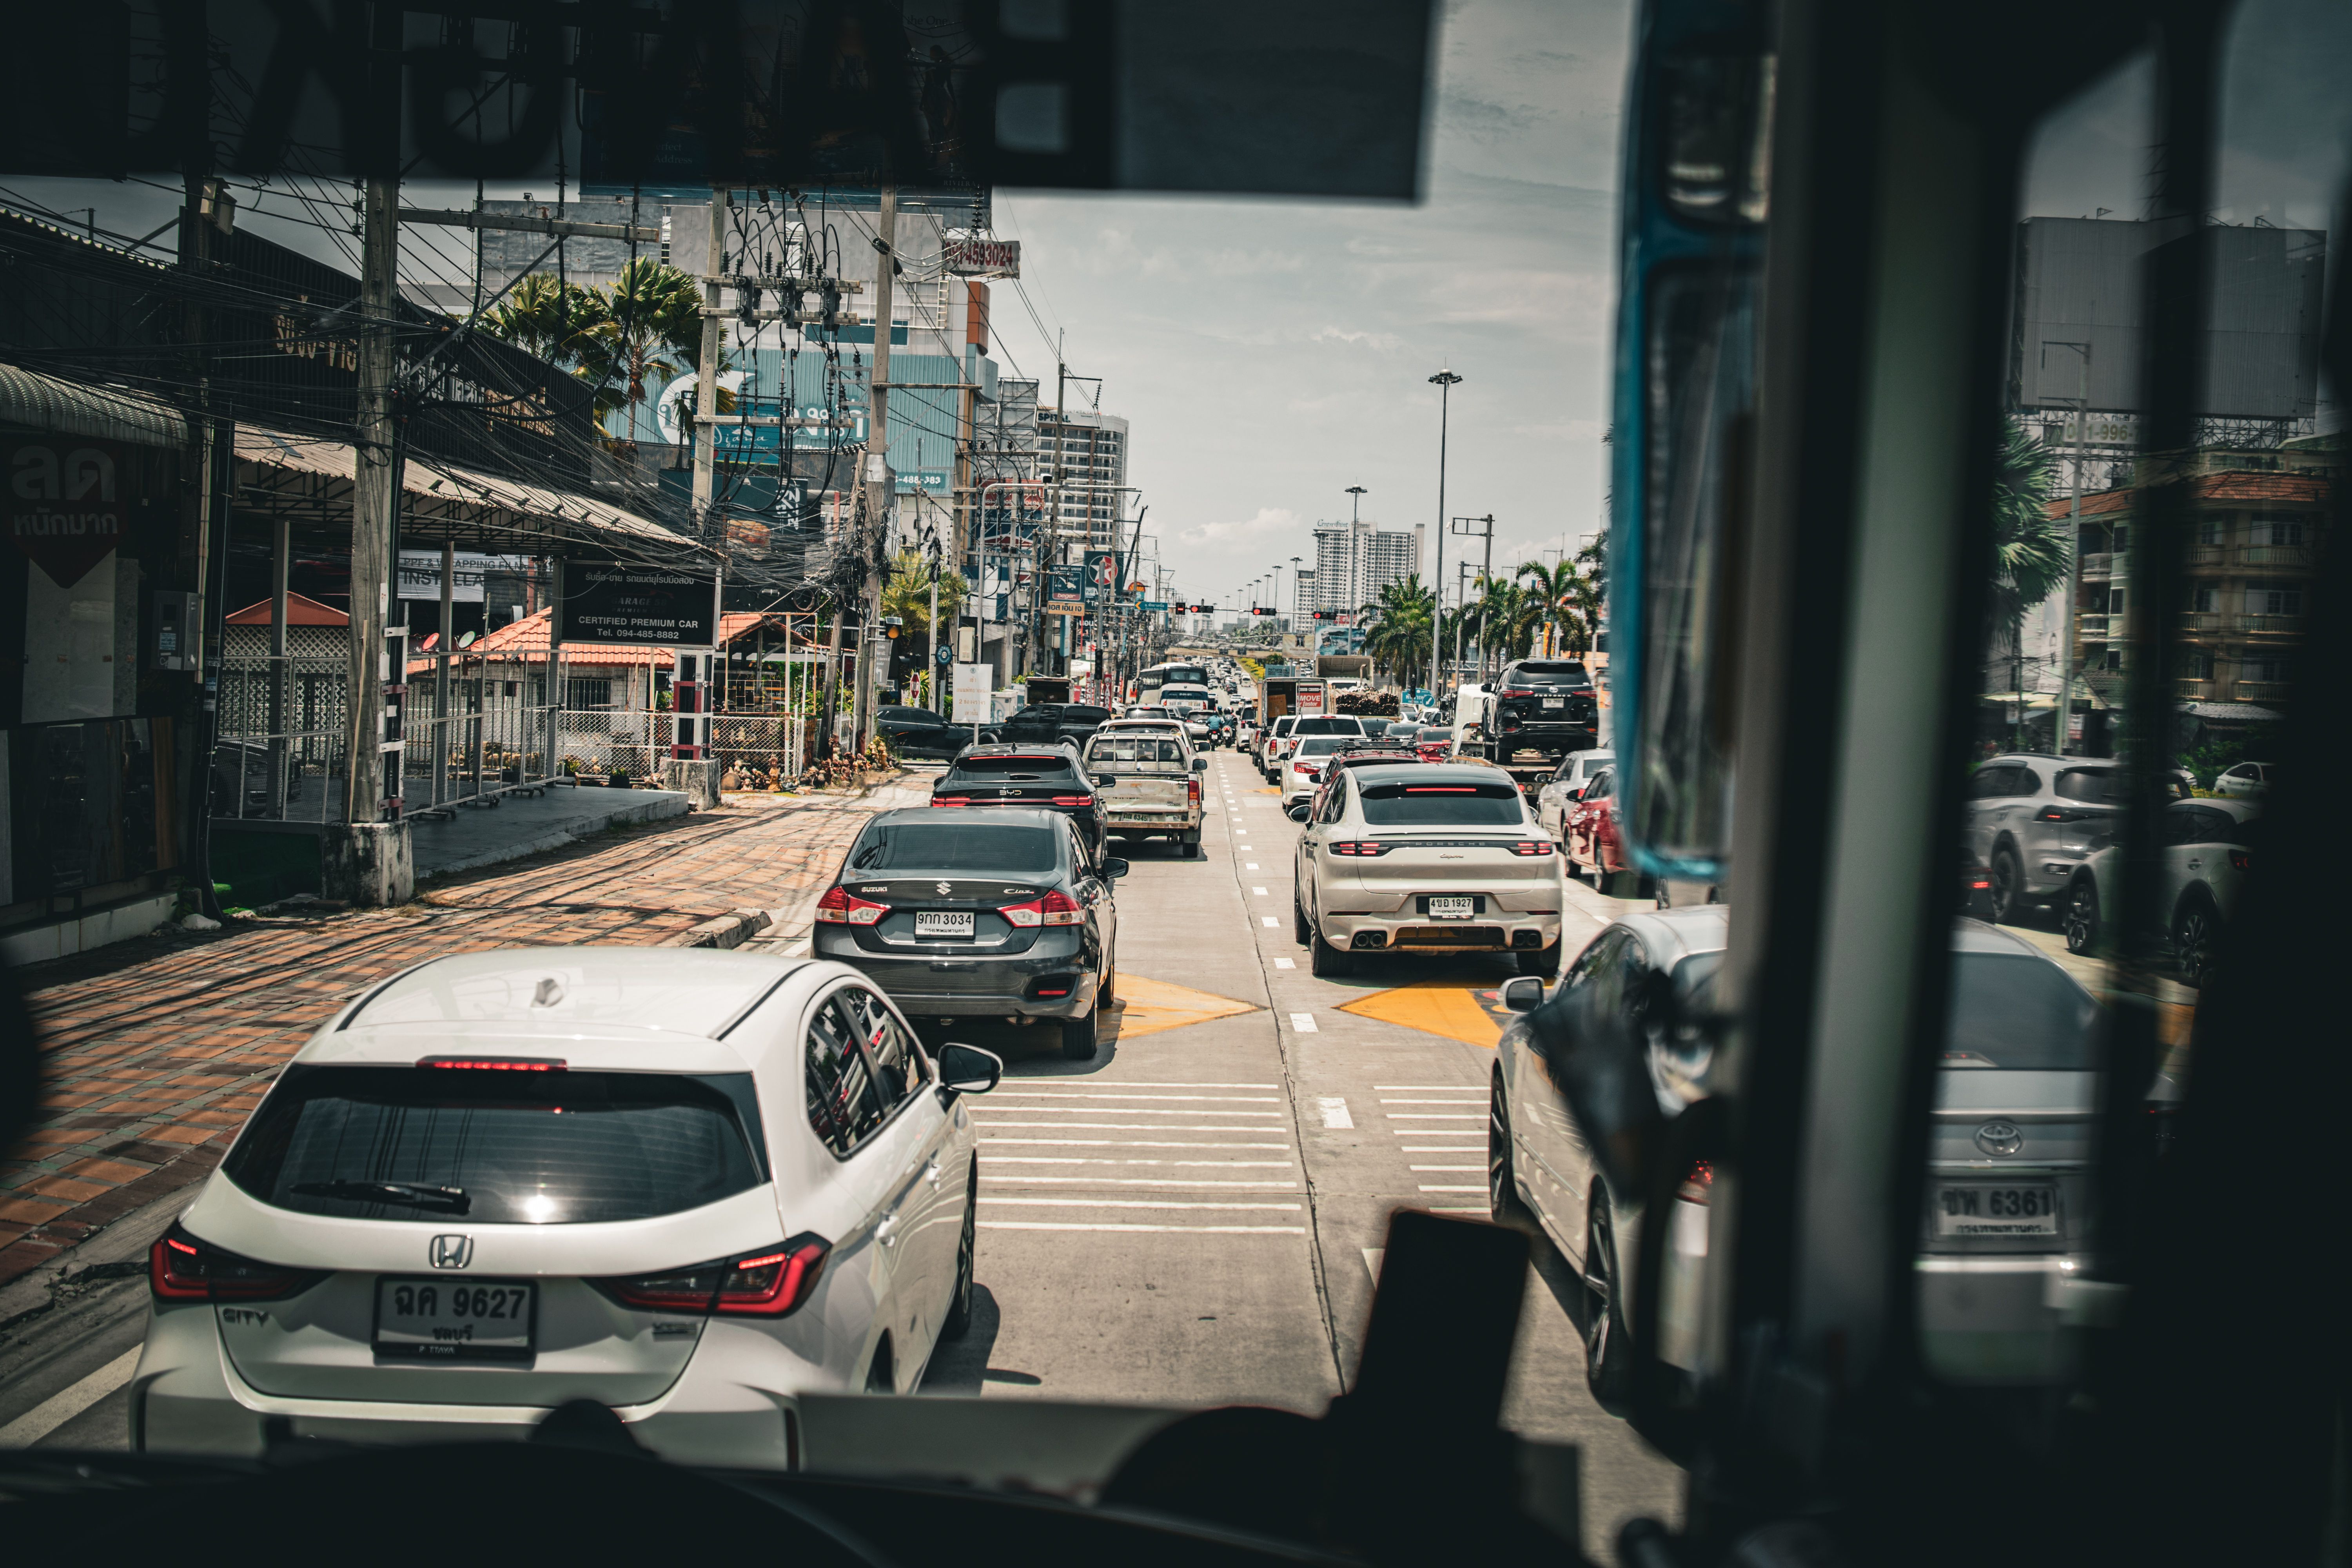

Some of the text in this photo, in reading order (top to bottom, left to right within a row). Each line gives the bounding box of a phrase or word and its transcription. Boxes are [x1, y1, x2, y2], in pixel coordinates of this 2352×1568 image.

[11, 445, 116, 503] ลด
[14, 506, 118, 535] หนักมาก
[437, 559, 495, 568] WAPPING
[611, 597, 651, 606] GARAGE
[579, 616, 627, 625] CERTIFIED
[631, 618, 675, 627] PREMIUM
[597, 628, 679, 639] Tel. 094-485-8882
[1452, 898, 1472, 907] 1927
[944, 914, 971, 925] 3034
[1990, 1190, 2051, 1216] 6361
[452, 1286, 526, 1320] 9627
[222, 1308, 269, 1327] CITY
[432, 1323, 473, 1345] ชลบุรี
